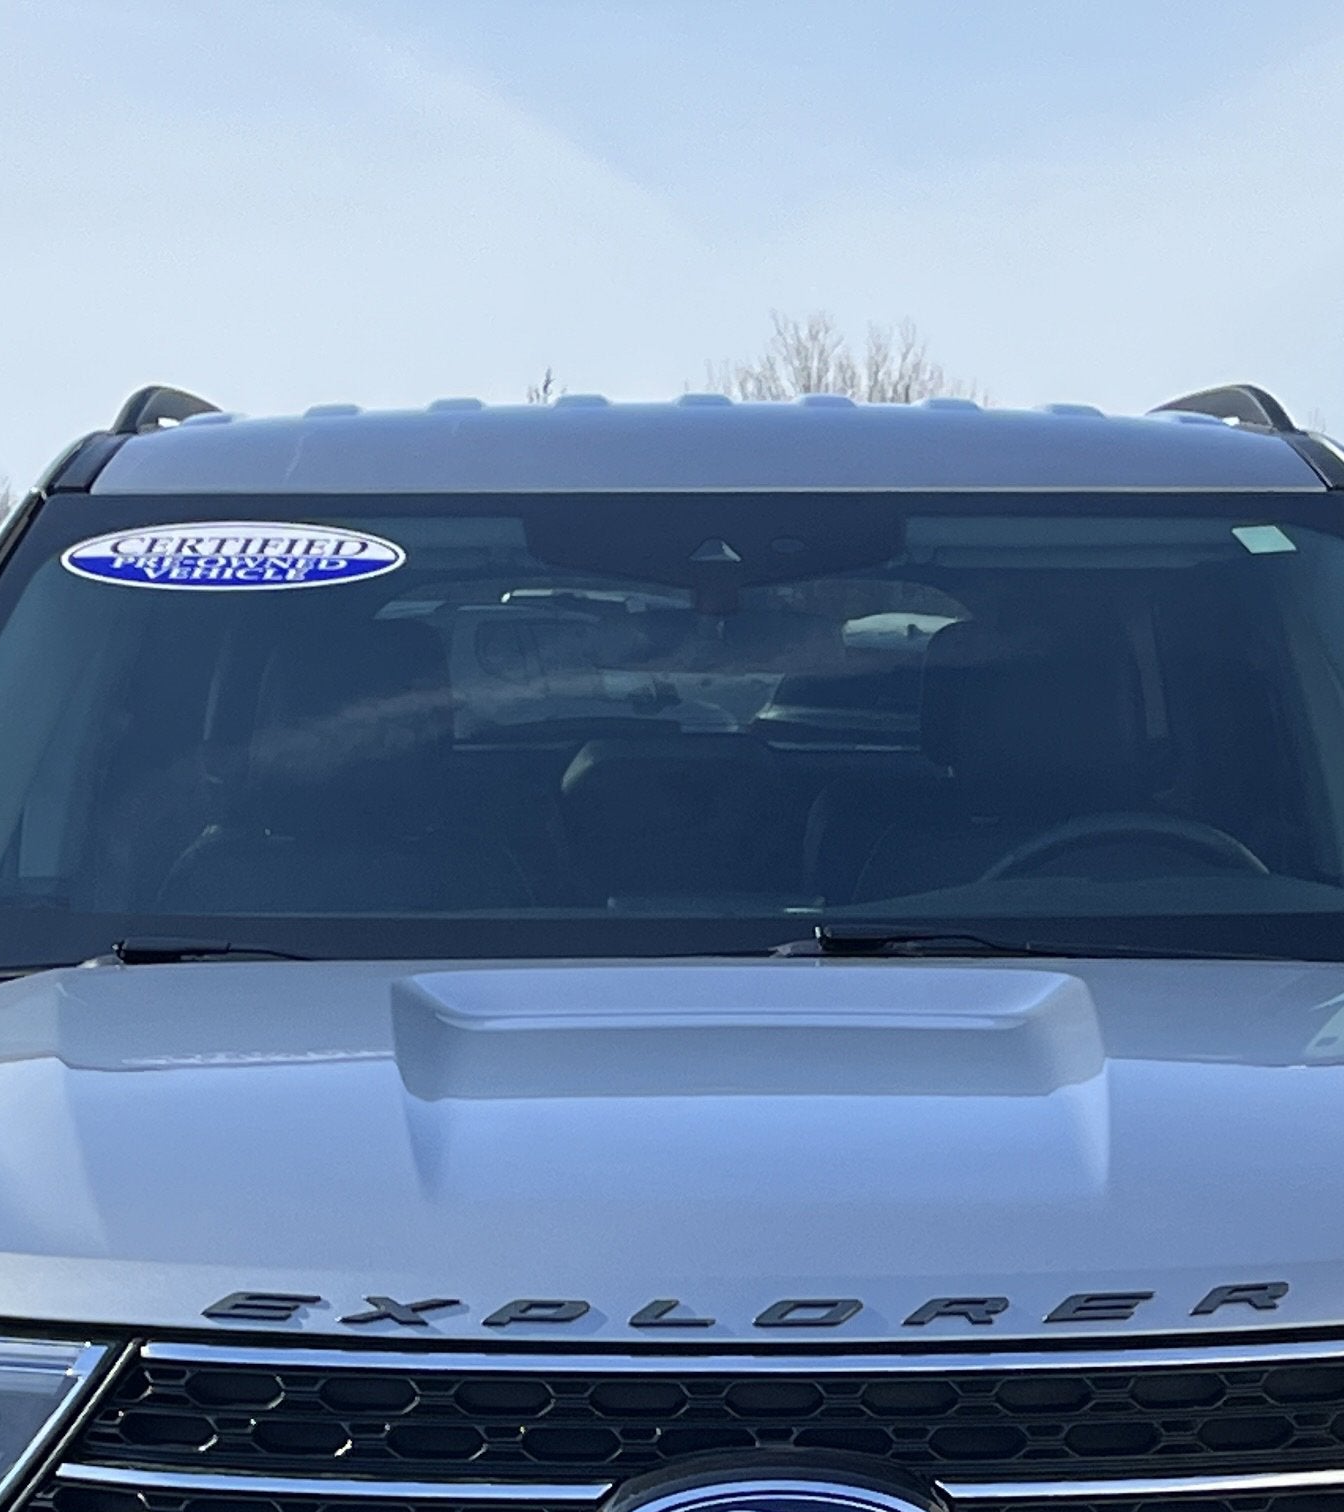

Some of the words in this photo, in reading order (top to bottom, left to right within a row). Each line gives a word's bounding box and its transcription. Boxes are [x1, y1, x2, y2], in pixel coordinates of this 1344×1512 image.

[111, 537, 369, 556] CERTIFIED
[111, 555, 349, 570] PRE-OWNED
[143, 567, 306, 581] VEHICLE
[201, 1282, 1290, 1327] EXPLORER
